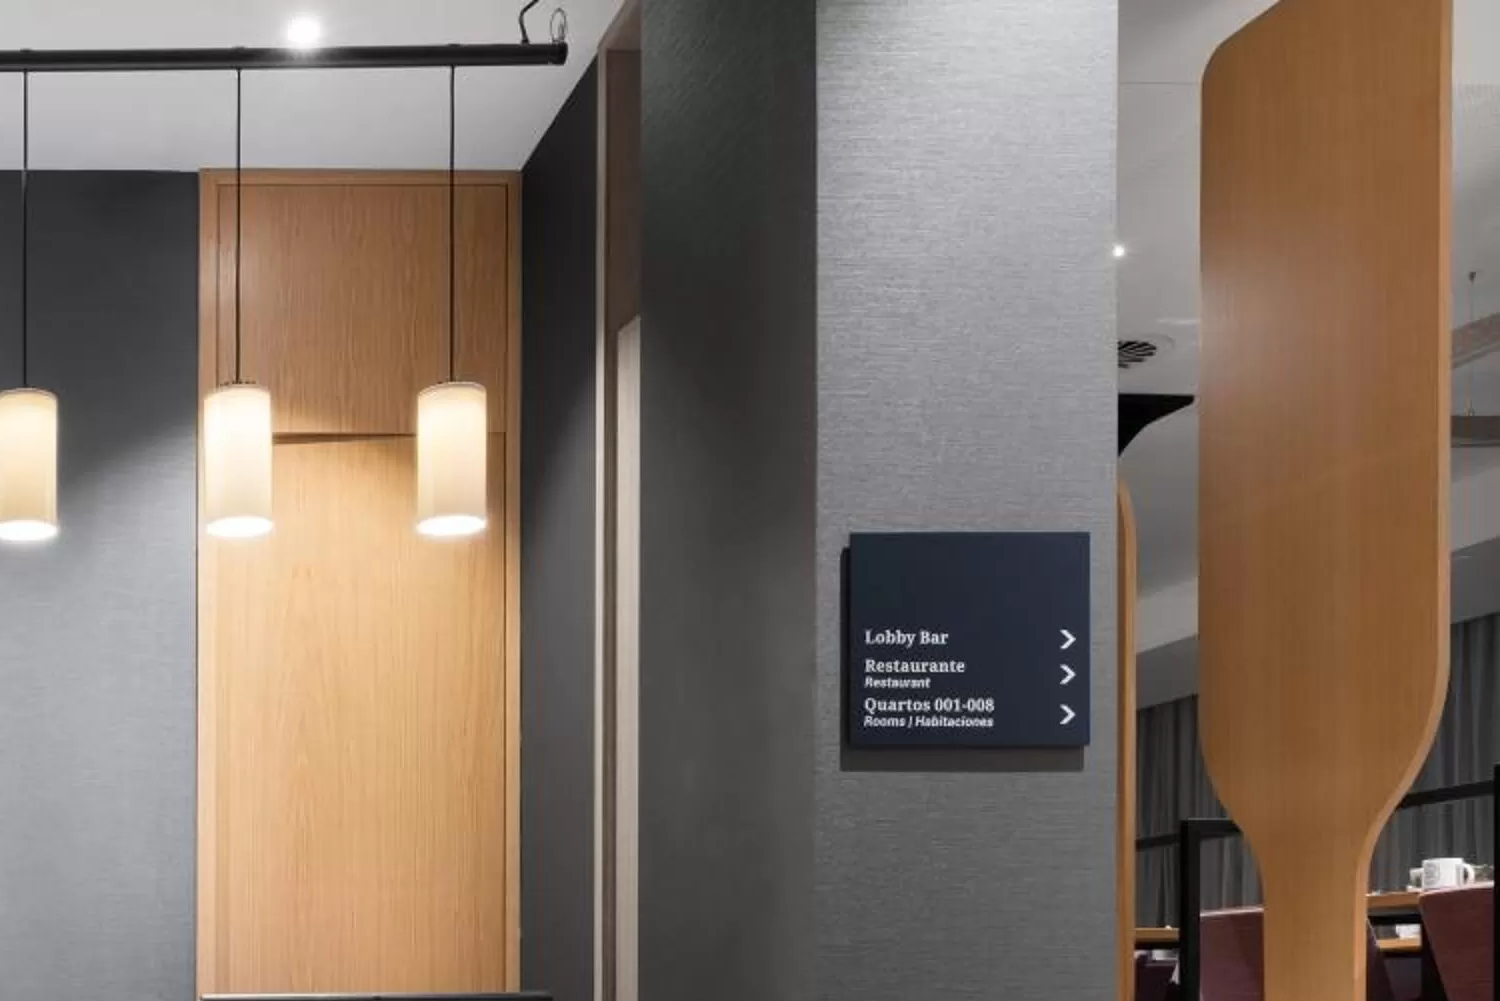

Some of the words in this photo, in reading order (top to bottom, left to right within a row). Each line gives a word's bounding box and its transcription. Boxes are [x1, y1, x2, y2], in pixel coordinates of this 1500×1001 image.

[865, 630, 916, 648] Lobby
[919, 630, 949, 645] Bar
[864, 658, 965, 673] Restaurante
[864, 676, 931, 689] Restaurant
[864, 697, 931, 714] Quartos
[934, 697, 995, 712] 001-008
[863, 715, 906, 727] Rooms
[915, 715, 994, 727] Habitaciones
